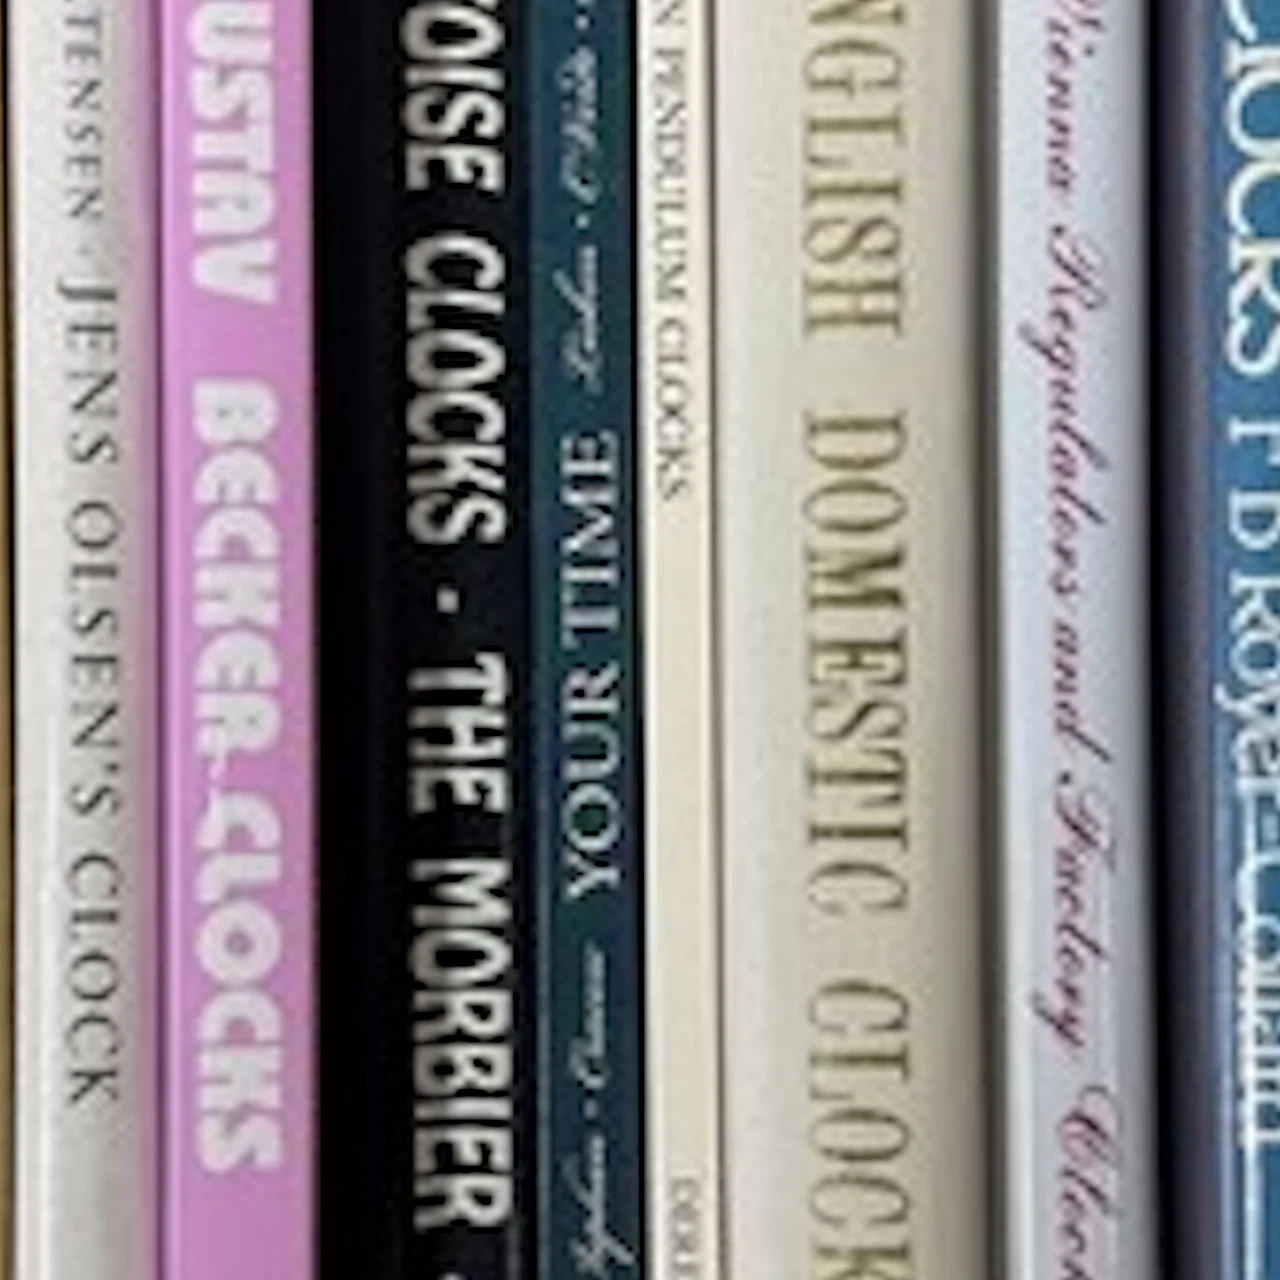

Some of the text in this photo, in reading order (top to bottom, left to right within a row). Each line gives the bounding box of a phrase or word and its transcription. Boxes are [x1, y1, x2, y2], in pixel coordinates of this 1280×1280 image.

[404, 231, 509, 546] CLOCKS
[653, 317, 694, 503] CLOCKS
[1020, 222, 1110, 600] Regulators
[560, 430, 619, 652] TIME
[803, 411, 909, 915] DOMESTIC
[1050, 622, 1112, 762] and
[56, 275, 123, 1110] JENS OLSEN'S CLOCK
[407, 650, 509, 817] THE
[560, 662, 620, 901] YOUR
[195, 790, 284, 1175] CLOCKS
[408, 858, 515, 1233] MORBIER
[1030, 769, 1116, 1059] Factory
